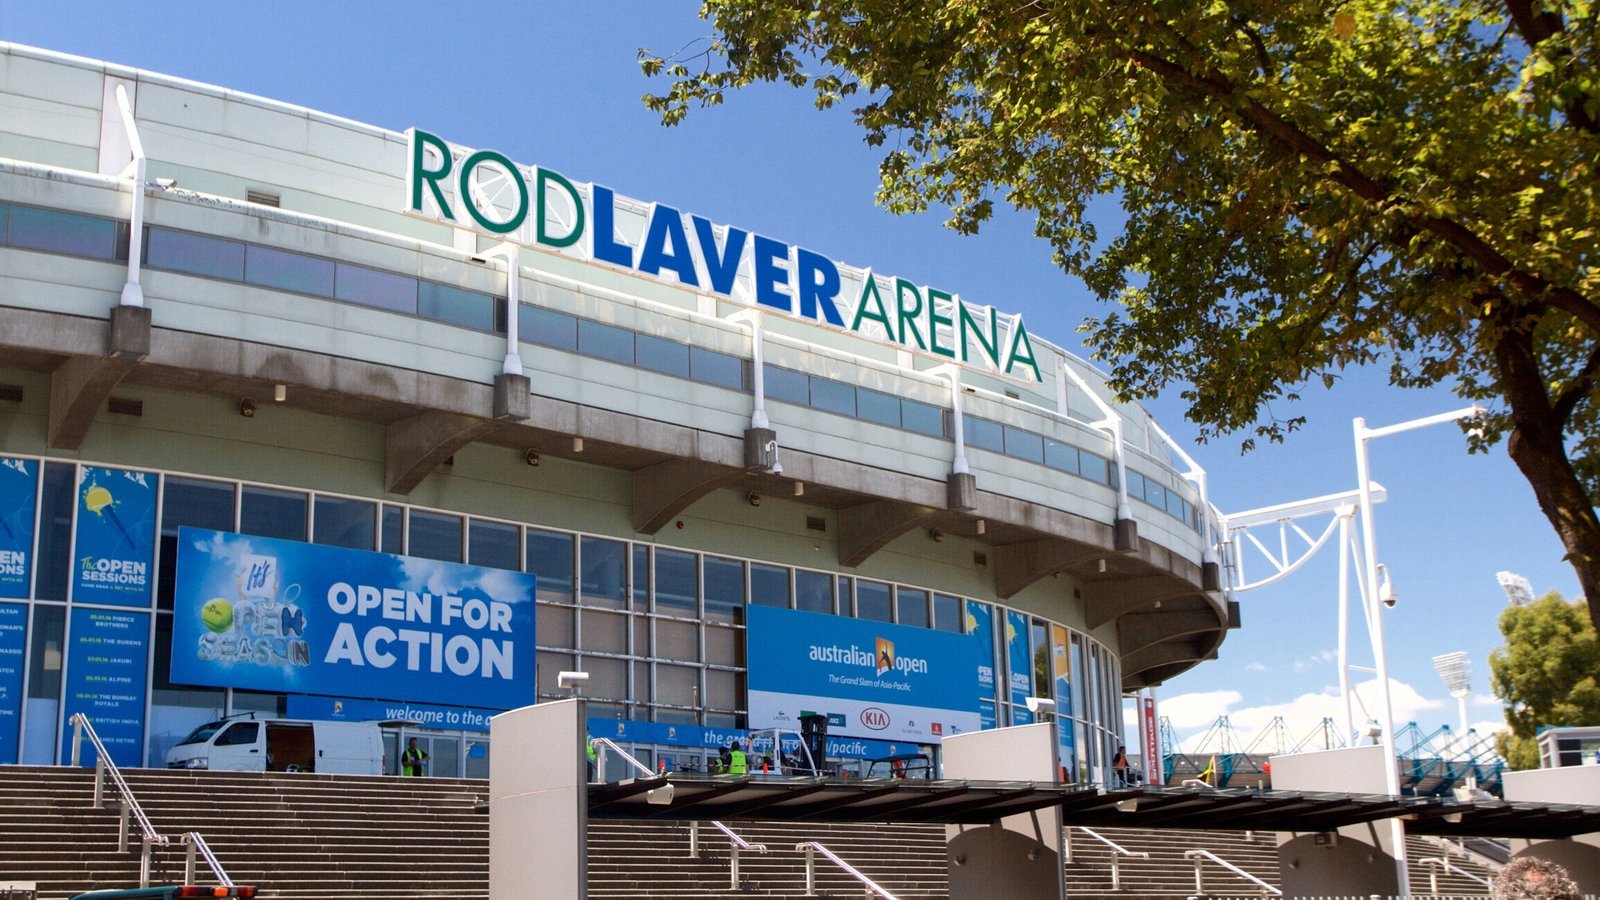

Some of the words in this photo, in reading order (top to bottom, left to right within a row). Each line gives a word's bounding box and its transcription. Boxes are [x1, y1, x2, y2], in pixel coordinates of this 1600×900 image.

[412, 130, 585, 248] ROD
[593, 183, 845, 328] LAVER
[852, 270, 1043, 383] ARENA
[97, 558, 147, 575] OPEN
[81, 570, 146, 585] SESSIONS
[327, 582, 431, 624] OPEN
[442, 596, 513, 633] FOR
[324, 622, 514, 680] ACTION
[809, 644, 875, 667] australian
[896, 656, 928, 676] open
[828, 674, 839, 683] The
[840, 675, 858, 686] Grand
[859, 677, 873, 686] Slam
[873, 679, 880, 688] of
[386, 706, 443, 723] welcome
[446, 711, 459, 724] to
[462, 710, 483, 726] the
[704, 729, 723, 744] the
